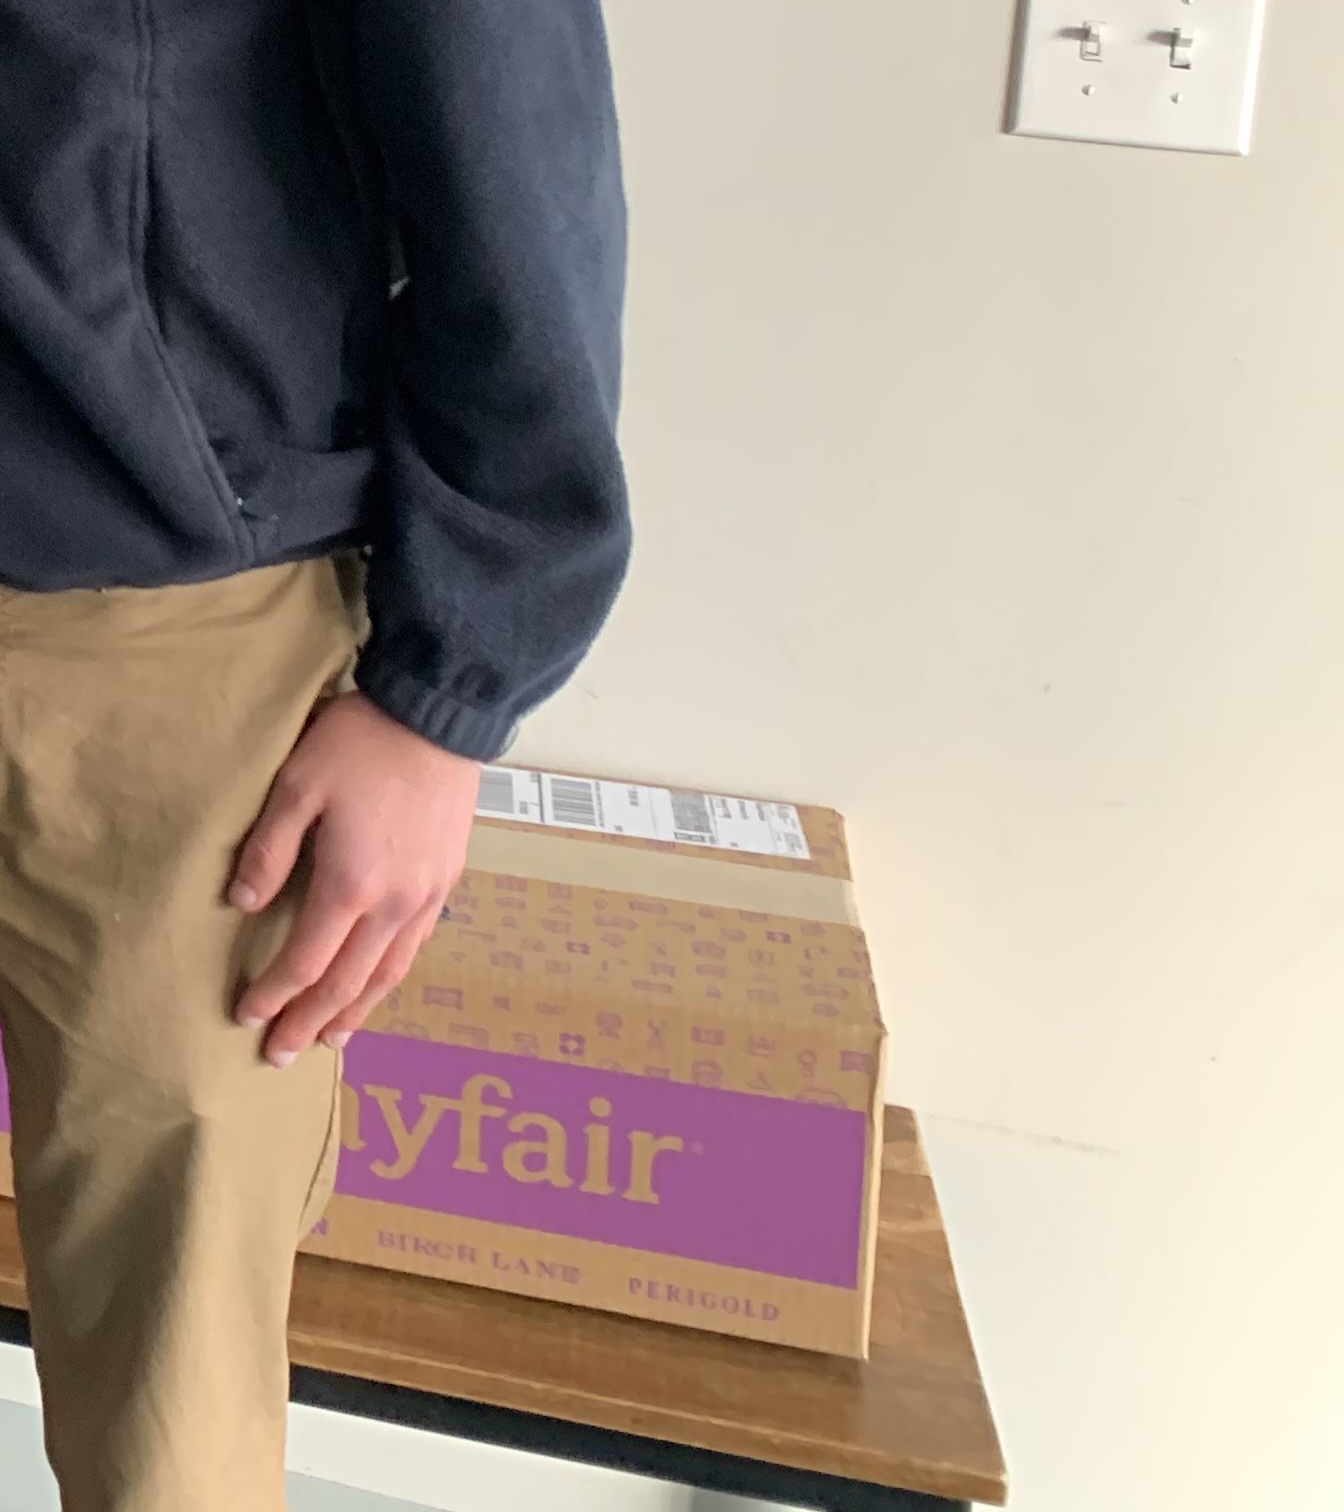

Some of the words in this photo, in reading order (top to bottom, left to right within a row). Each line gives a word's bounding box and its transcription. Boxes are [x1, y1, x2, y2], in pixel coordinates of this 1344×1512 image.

[341, 1073, 684, 1205] yfair
[377, 1230, 477, 1265] BIRCH
[492, 1251, 581, 1285] LANE
[628, 1276, 780, 1322] PERIGOLD
